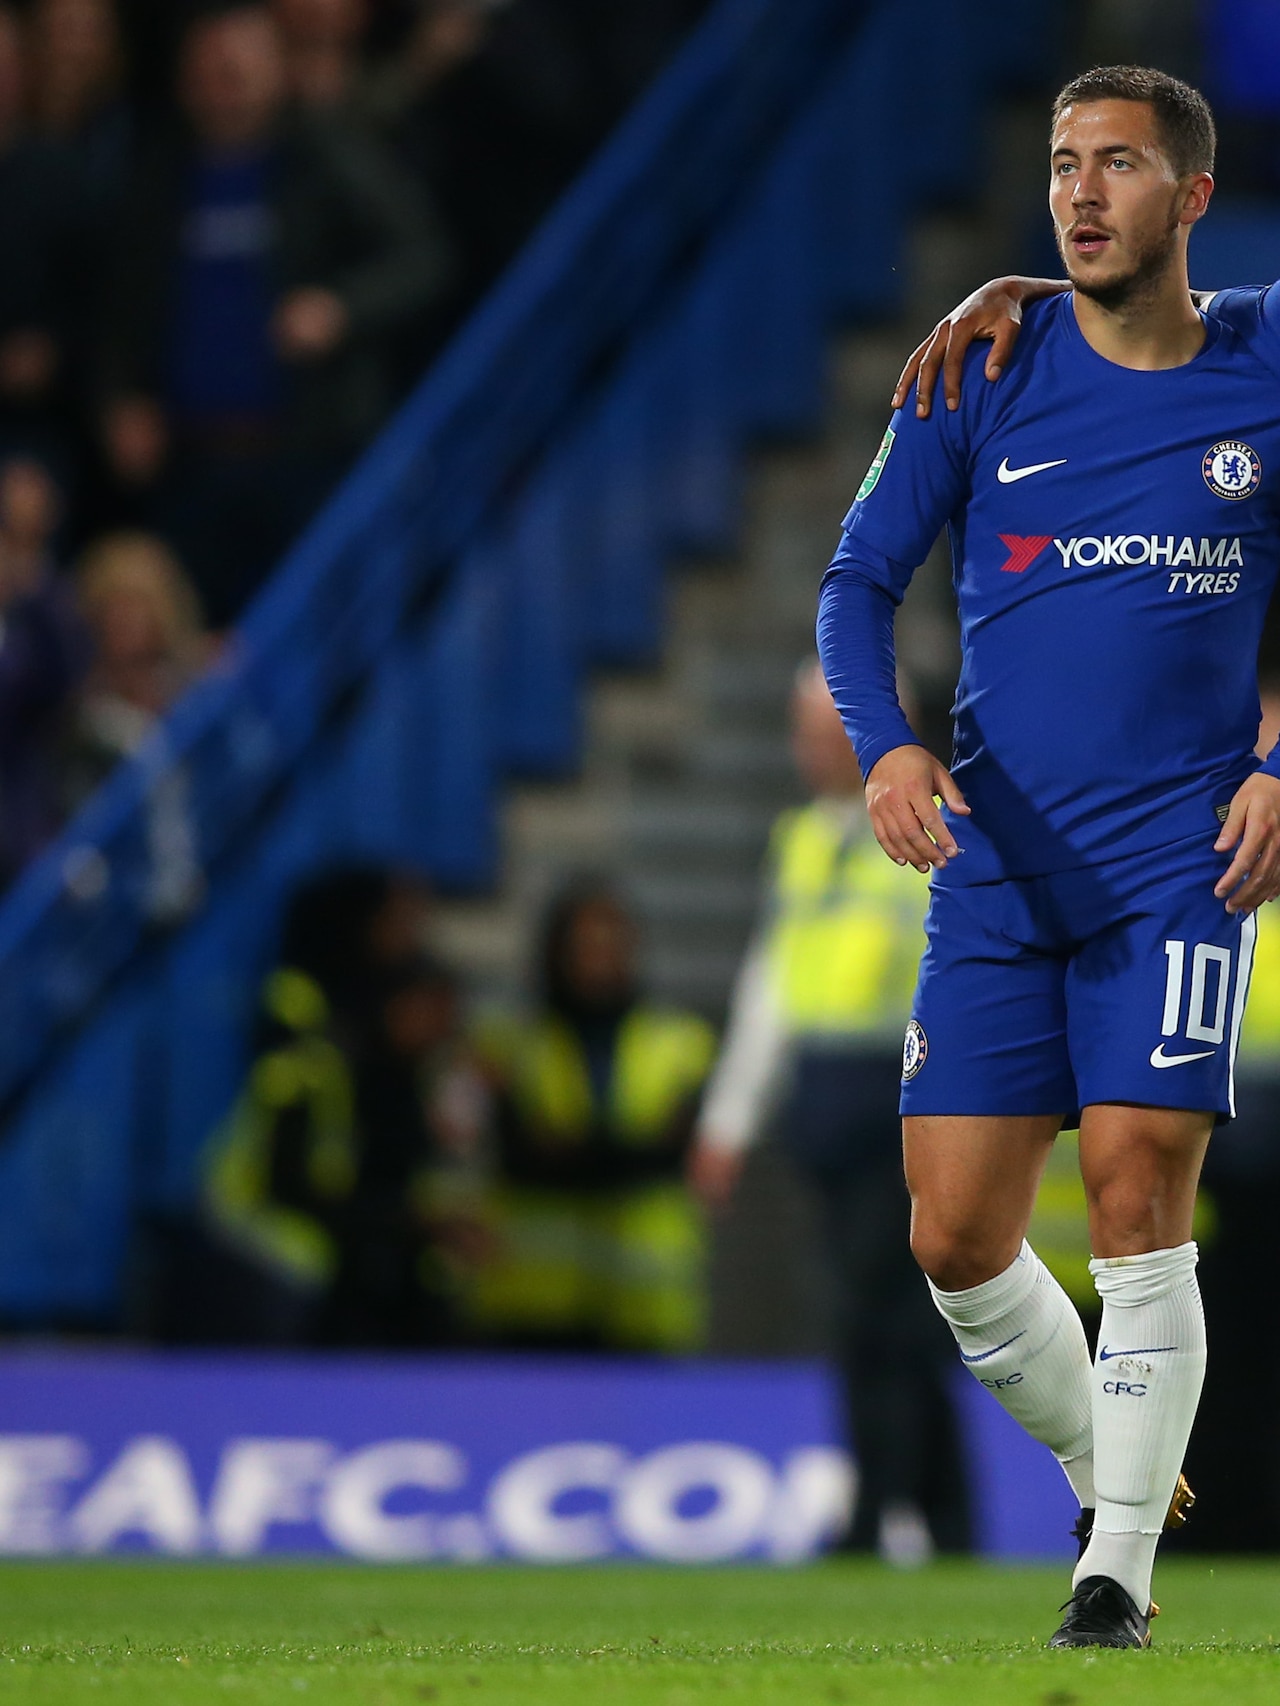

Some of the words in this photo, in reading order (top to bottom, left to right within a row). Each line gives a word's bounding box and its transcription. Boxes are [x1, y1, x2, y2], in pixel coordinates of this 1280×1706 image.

[1213, 443, 1252, 458] CHELSEA
[1053, 536, 1243, 567] YOKOHAMA
[1167, 572, 1241, 593] TYRES
[1163, 940, 1231, 1044] 10
[980, 1373, 1024, 1389] CFC
[1103, 1381, 1147, 1397] CFC
